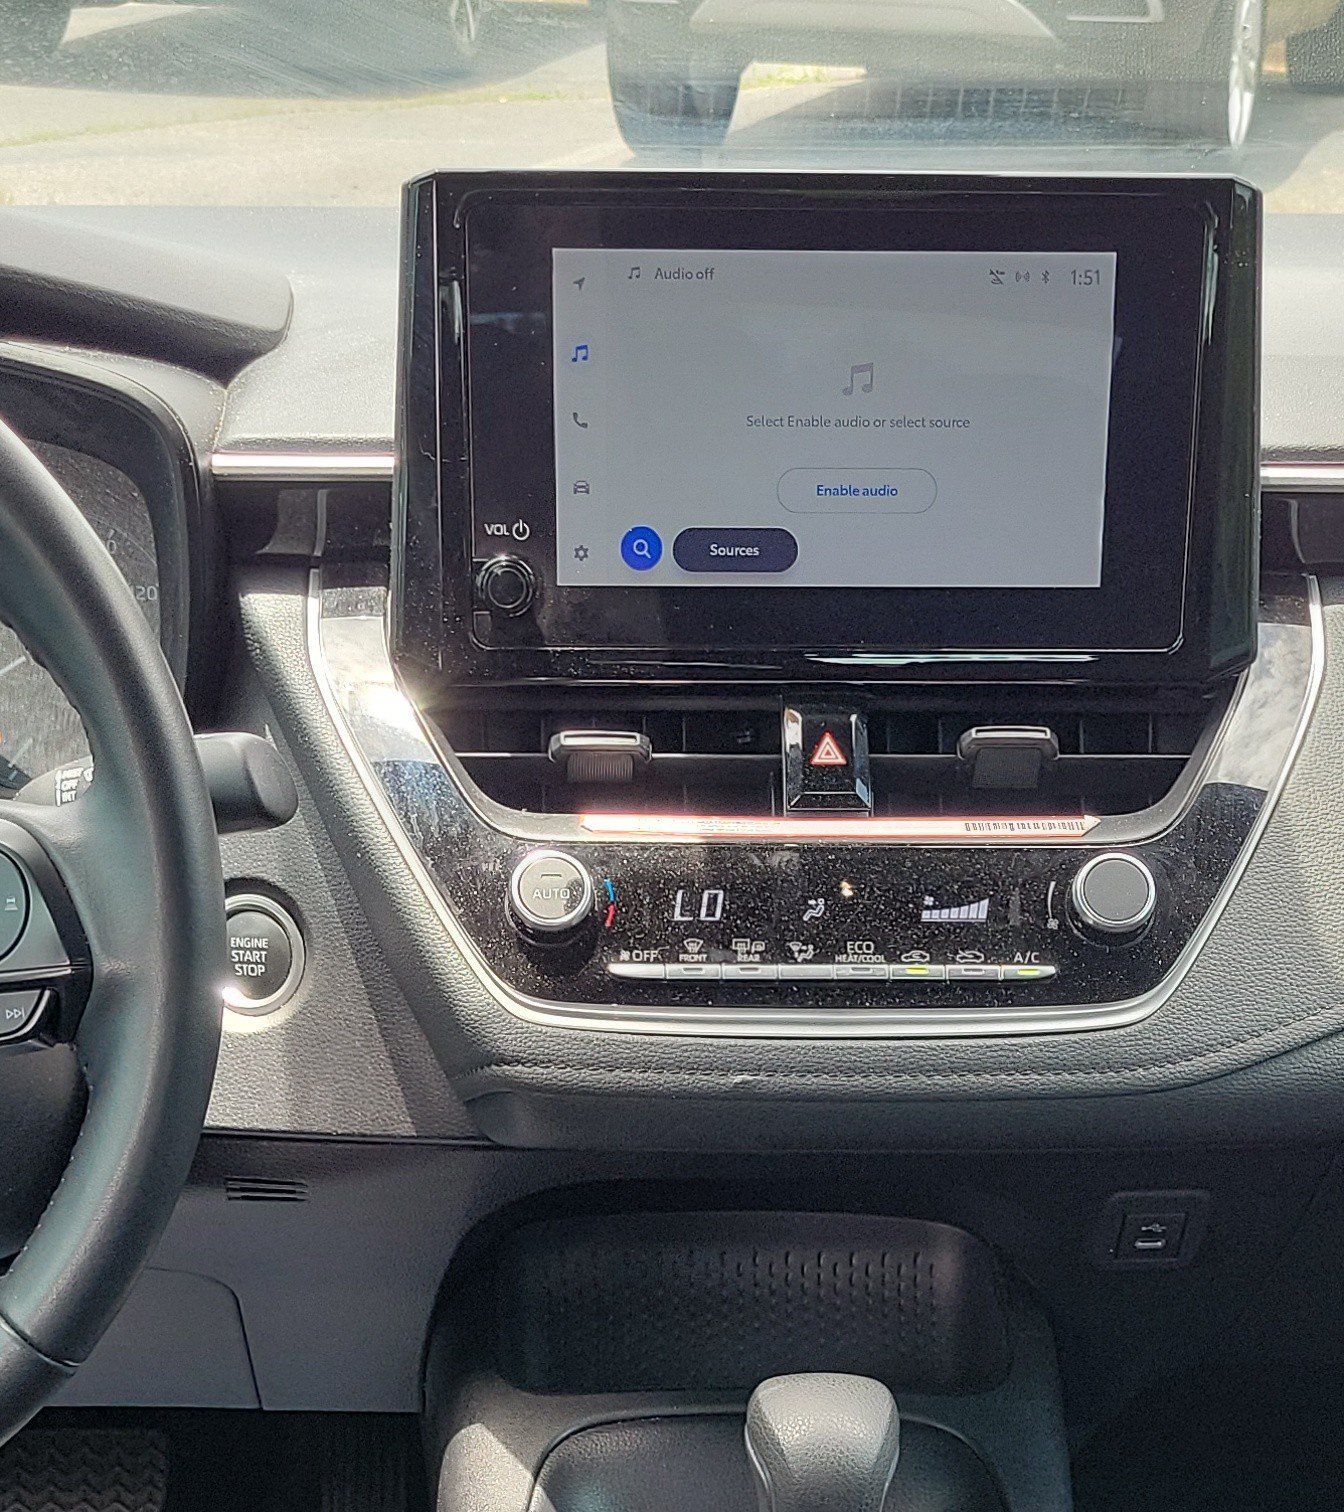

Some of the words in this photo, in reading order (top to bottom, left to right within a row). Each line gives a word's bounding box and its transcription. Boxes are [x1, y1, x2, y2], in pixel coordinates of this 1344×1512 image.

[654, 267, 694, 280] Audio
[695, 267, 715, 280] off
[1070, 269, 1101, 286] 1:51
[746, 415, 784, 428] Select
[787, 415, 831, 428] Enable
[834, 415, 870, 428] audio
[873, 418, 887, 428] or
[889, 415, 926, 428] select
[929, 418, 971, 429] source
[816, 485, 860, 497] Enable
[862, 485, 898, 497] audio
[484, 523, 510, 537] VOL
[709, 543, 760, 557] Sources
[532, 887, 571, 900] AUTO
[673, 888, 724, 922] LO
[230, 937, 269, 949] ENGINE
[846, 941, 875, 954] ECO
[231, 950, 268, 963] START
[632, 950, 658, 963] OFF
[678, 953, 708, 963] FRONT
[736, 953, 761, 963] REAR
[834, 953, 887, 964] HEAT/COOL
[1013, 951, 1041, 964] A/C
[235, 964, 266, 977] STOP
